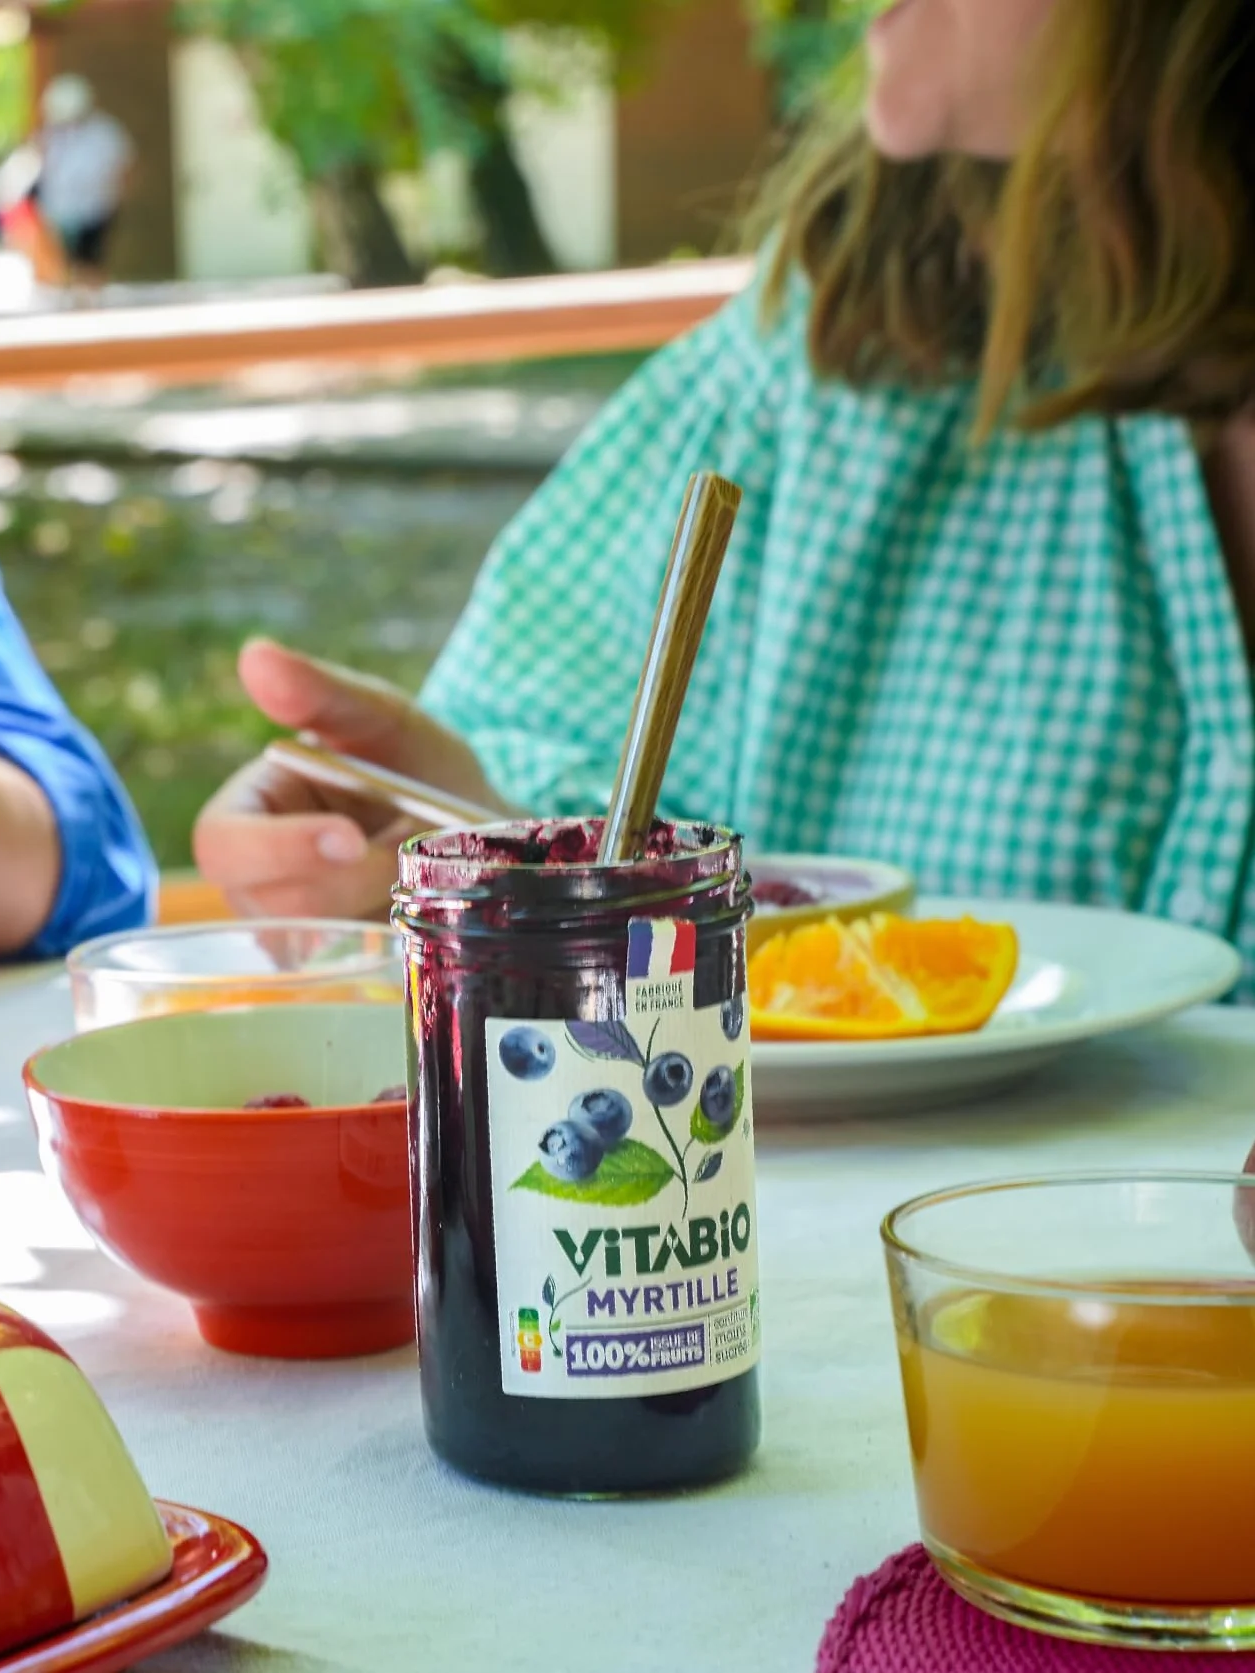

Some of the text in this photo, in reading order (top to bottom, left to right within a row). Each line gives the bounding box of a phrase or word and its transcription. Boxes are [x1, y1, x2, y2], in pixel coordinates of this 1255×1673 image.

[650, 995, 684, 1011] FRANCE
[587, 1267, 739, 1318] MYRTILLE
[714, 1324, 747, 1347] moins
[570, 1339, 651, 1371] 100%
[650, 1346, 703, 1368] FRUITS
